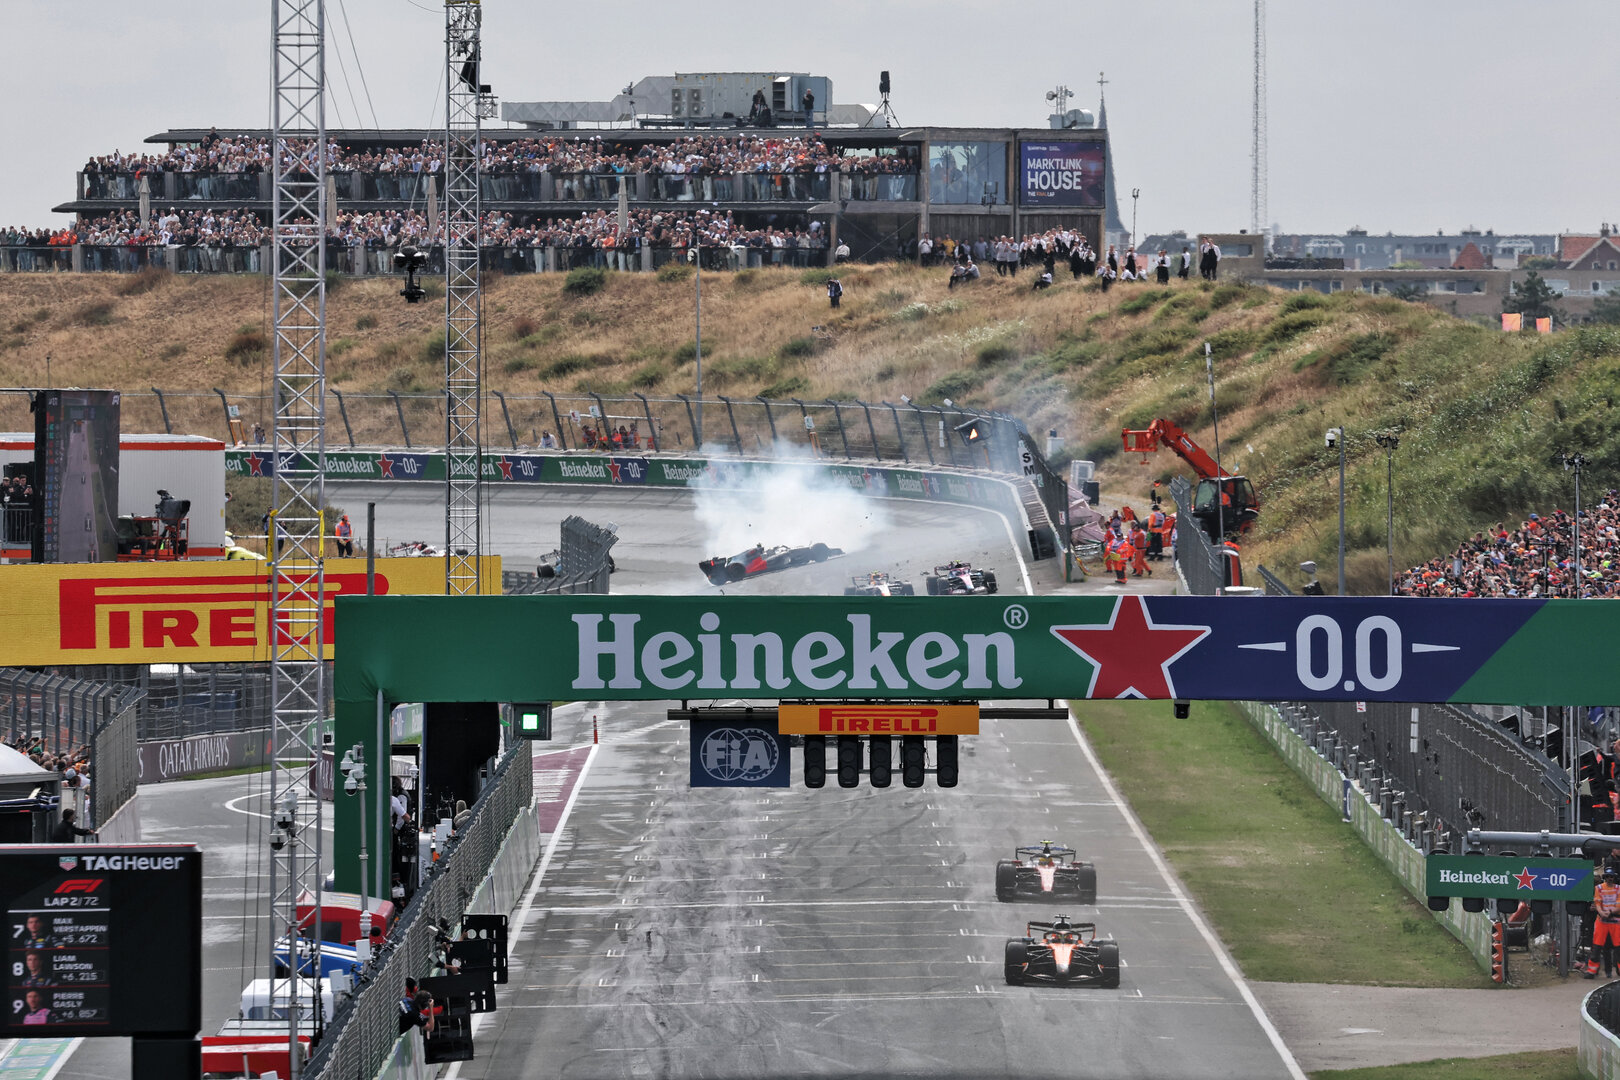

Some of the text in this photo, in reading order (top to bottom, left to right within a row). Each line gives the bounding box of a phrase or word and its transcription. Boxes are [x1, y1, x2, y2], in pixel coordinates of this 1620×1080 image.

[1027, 158, 1082, 170] MARKTLINK
[1027, 171, 1082, 190] HOUSE
[559, 461, 606, 478] Heineken
[60, 573, 389, 649] PIREL
[1296, 614, 1402, 692] 0.0
[818, 708, 939, 732] PIRELLI
[159, 741, 192, 778] QATAR
[193, 737, 230, 770] AIRWAYS
[1439, 869, 1567, 887] Heineken 0.0
[44, 897, 69, 906] LAP
[13, 924, 25, 939] 7
[12, 962, 24, 976] 8
[53, 963, 93, 971] LAWSON
[12, 999, 24, 1014] 9
